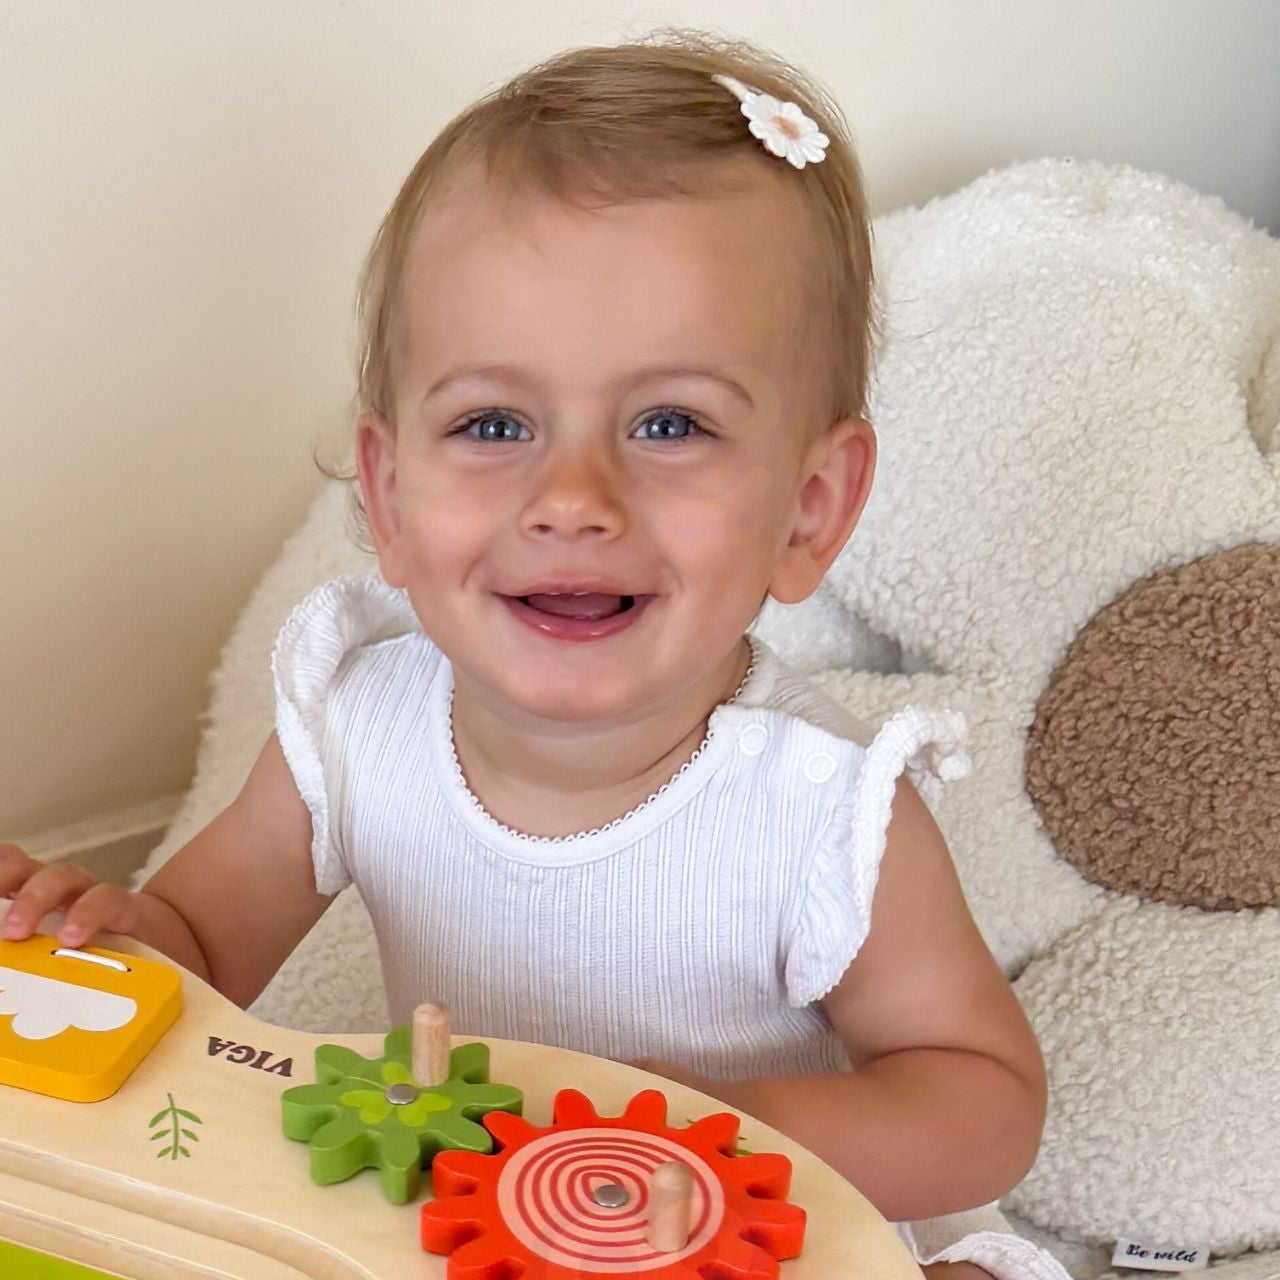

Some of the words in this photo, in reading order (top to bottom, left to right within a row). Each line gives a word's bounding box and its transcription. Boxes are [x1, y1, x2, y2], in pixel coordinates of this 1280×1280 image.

[207, 1036, 293, 1077] VIGA
[1126, 1243, 1150, 1258] Be
[1153, 1250, 1198, 1263] wild
